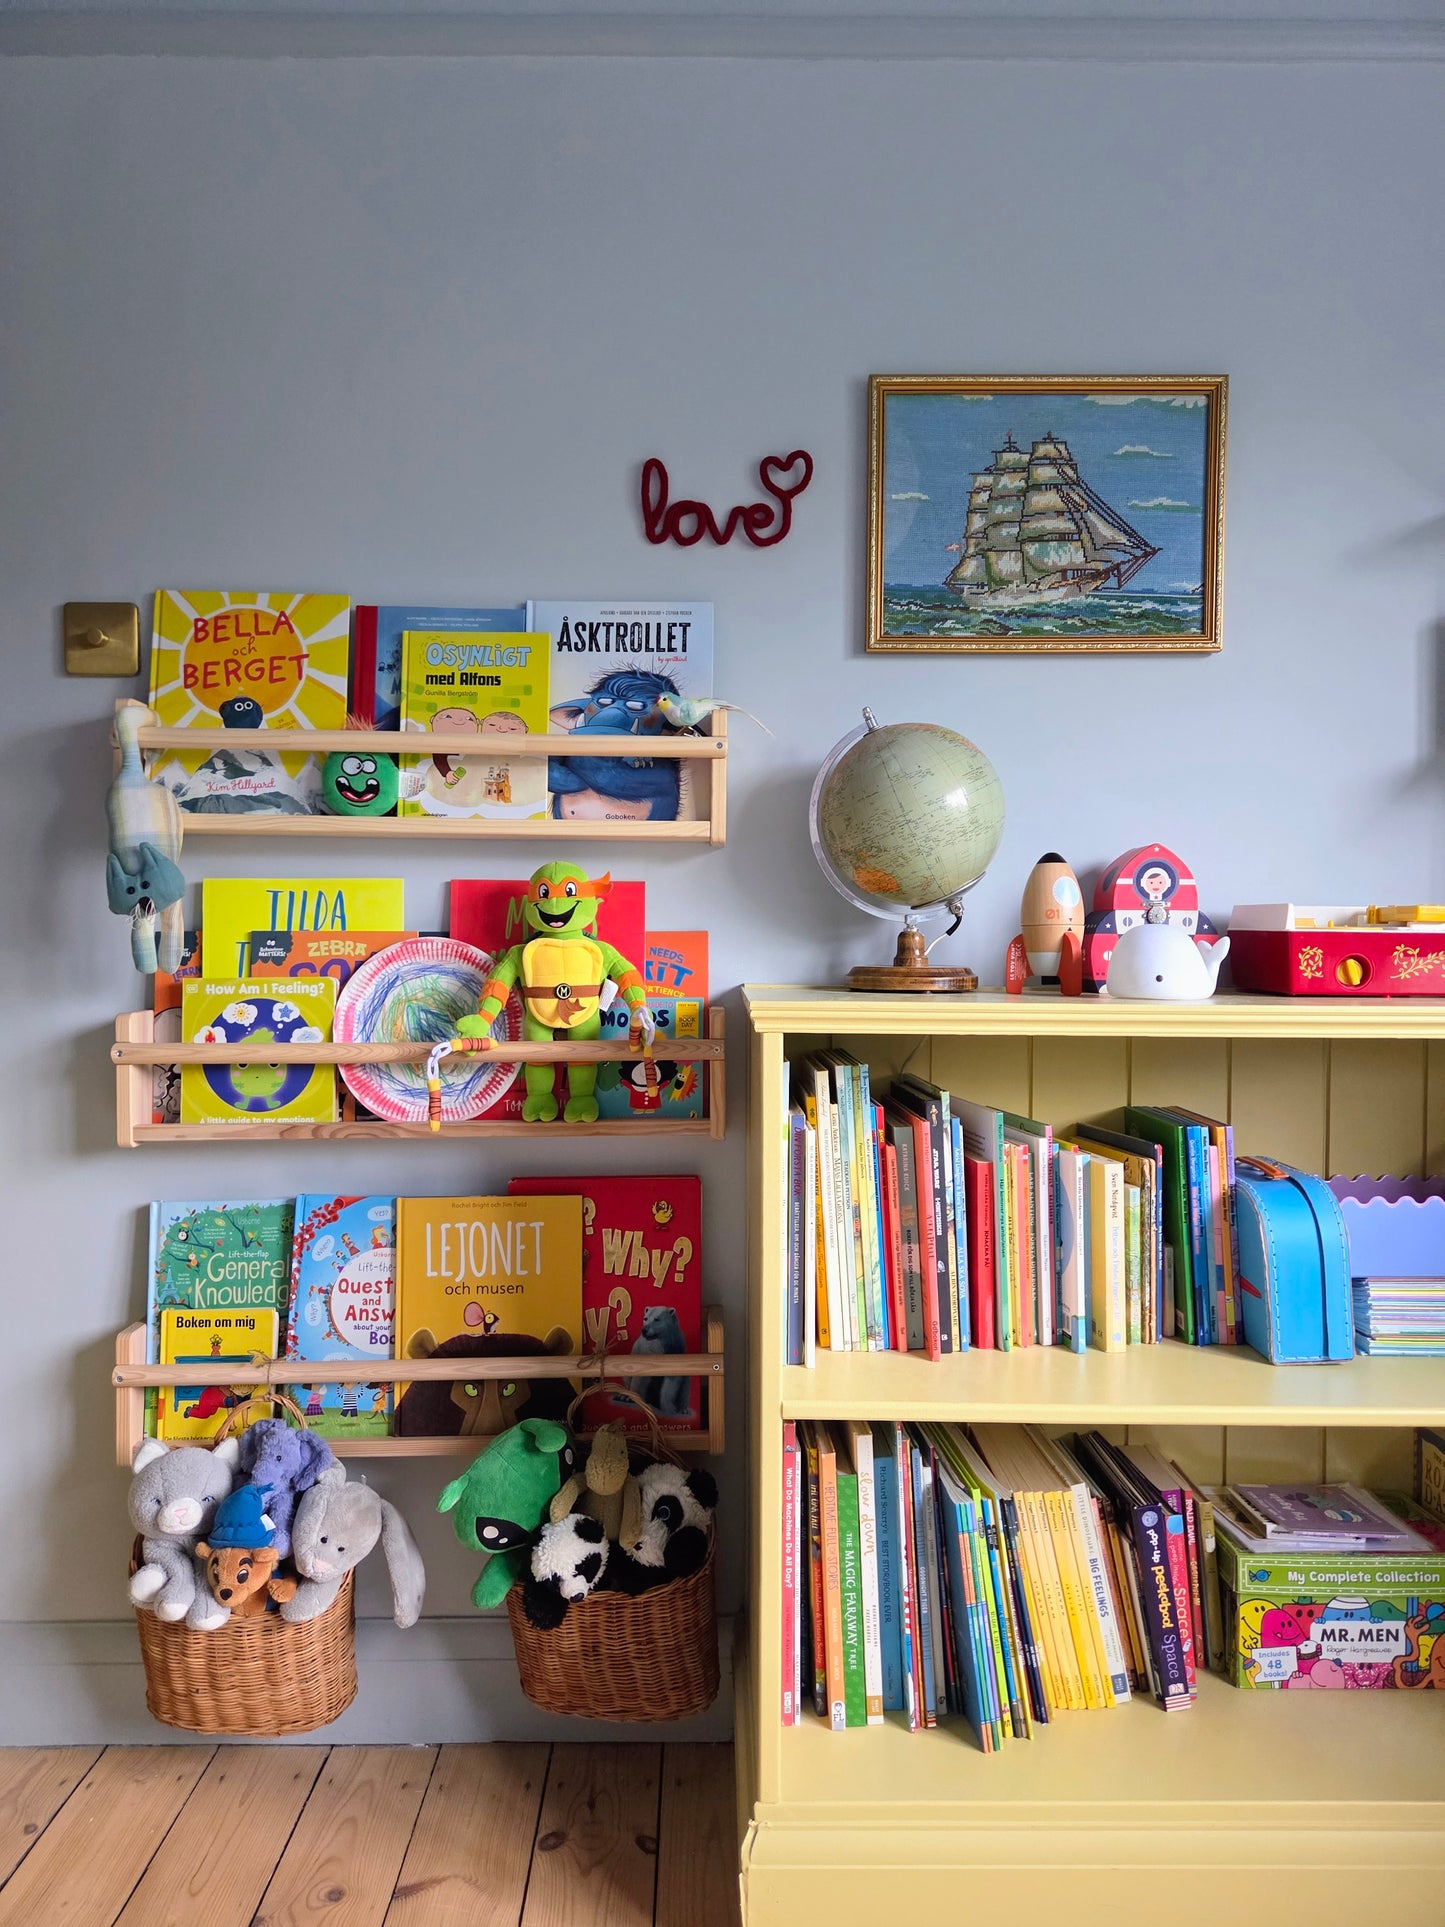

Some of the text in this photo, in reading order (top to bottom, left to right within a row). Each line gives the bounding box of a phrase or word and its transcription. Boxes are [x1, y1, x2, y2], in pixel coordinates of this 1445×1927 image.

[641, 452, 808, 546] love
[194, 610, 294, 644] BELLA
[557, 616, 691, 652] ÅSKTROLLET
[232, 635, 258, 656] och
[183, 654, 310, 689] BERGET
[426, 672, 501, 686] med Alfons
[448, 690, 478, 698] Bergström
[205, 777, 276, 793] Kim Hillyard
[606, 813, 636, 821] Goboken
[266, 890, 346, 931] TILDA
[308, 940, 367, 957] ZEBRA
[650, 946, 684, 964] NEEDS
[206, 982, 324, 996] How Am I Feeling?
[645, 985, 685, 998] ATIENCE
[207, 1116, 226, 1124] little
[278, 1116, 314, 1124] emotions
[794, 1127, 802, 1144] DIN
[902, 1144, 910, 1172] KATARINA
[932, 1148, 940, 1168] STAR
[794, 1178, 802, 1196] BOK
[472, 1202, 490, 1210] Bright
[1110, 1189, 1118, 1218] Nordqvist
[228, 1250, 270, 1259] Lift-the-flap
[426, 1221, 544, 1282] LEJONET
[602, 1228, 692, 1288] Why?
[207, 1253, 290, 1282] General
[358, 1262, 397, 1272] Lift-the-
[195, 1278, 290, 1310] Knowledg
[338, 1277, 396, 1294] Quest
[445, 1282, 524, 1296] och musen
[362, 1296, 381, 1306] and
[345, 1305, 396, 1322] Answ
[176, 1316, 256, 1330] Boken om mig
[376, 1324, 392, 1335] your
[786, 1490, 792, 1500] Do
[860, 1472, 875, 1556] slow down
[1185, 1498, 1196, 1545] ROALD DAHL
[826, 1487, 838, 1590] BEDTIME FULL STORIES
[880, 1466, 892, 1623] Richard Scarry's BEST STORYBOOK EVER
[786, 1542, 792, 1554] Do
[846, 1550, 857, 1588] MAGIC
[1090, 1558, 1098, 1573] BIG
[784, 1568, 792, 1588] Day?
[920, 1566, 928, 1597] GOODNIGHT
[1288, 1571, 1440, 1584] My Complete Collection
[1092, 1575, 1108, 1618] FEELINGS
[1169, 1544, 1177, 1564] peep
[1174, 1588, 1188, 1639] Space
[845, 1592, 858, 1646] FARAWAY
[1147, 1528, 1184, 1694] pop-up peekaboo! Space DK
[1321, 1628, 1400, 1642] MR. MEN
[849, 1648, 857, 1670] TREE
[1258, 1650, 1290, 1659] Includes
[1263, 1670, 1288, 1678] books!
[1267, 1660, 1282, 1670] 48
